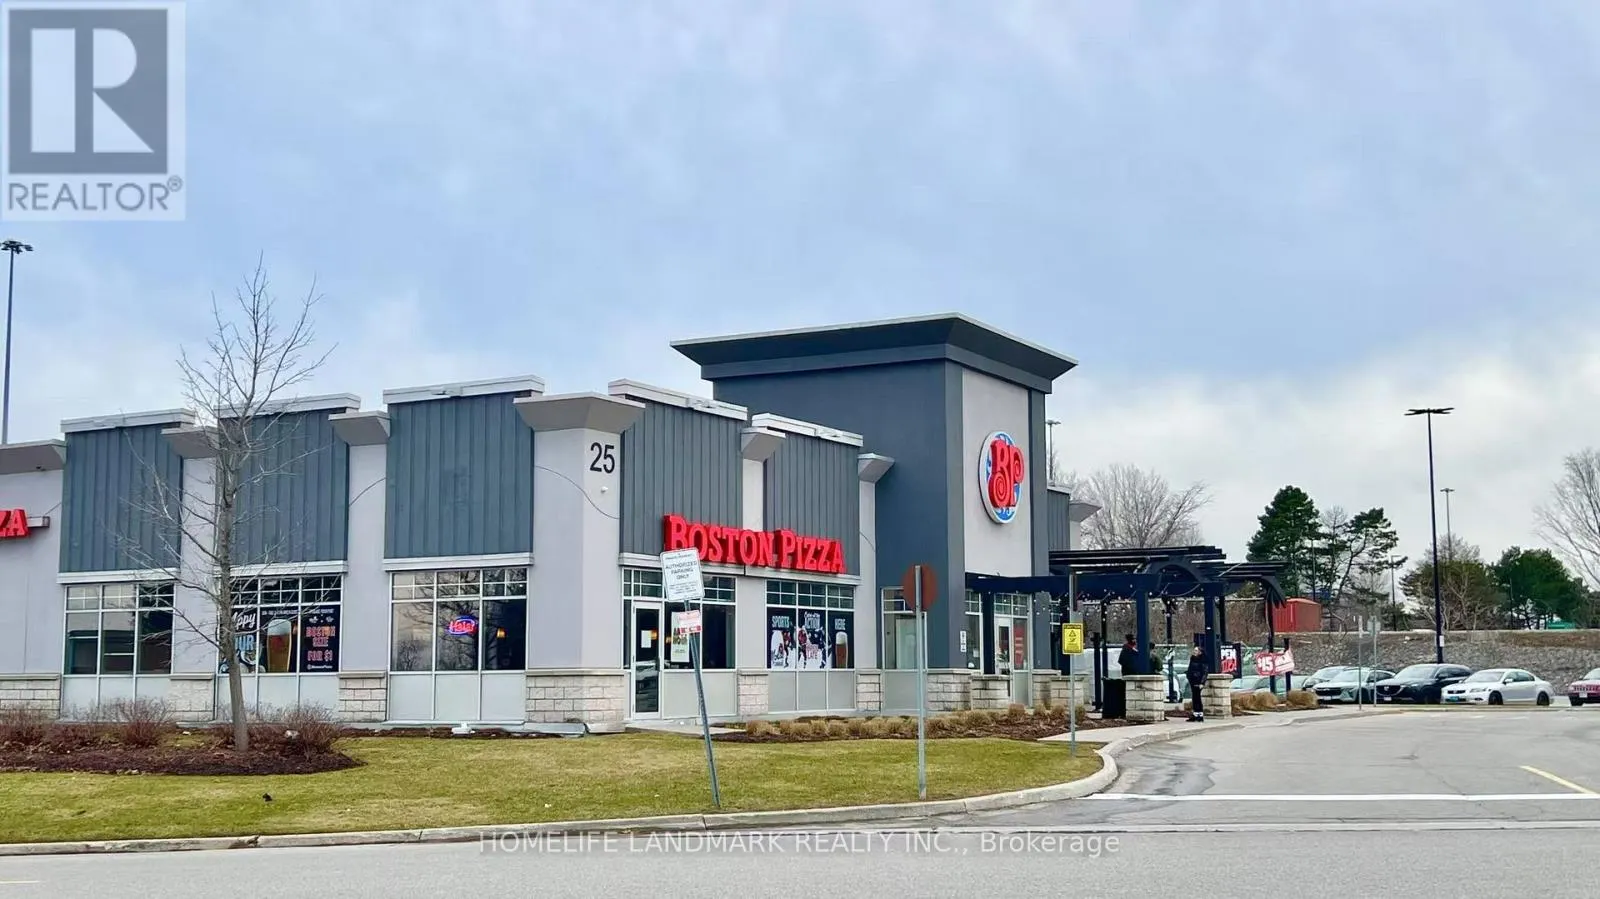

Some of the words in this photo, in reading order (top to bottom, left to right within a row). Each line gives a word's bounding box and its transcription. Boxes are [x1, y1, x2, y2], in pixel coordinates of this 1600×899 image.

[590, 441, 615, 474] 25
[988, 438, 1024, 509] BP
[663, 513, 774, 567] BOSTON
[775, 527, 847, 575] PIZZA
[771, 615, 790, 628] SPORTS
